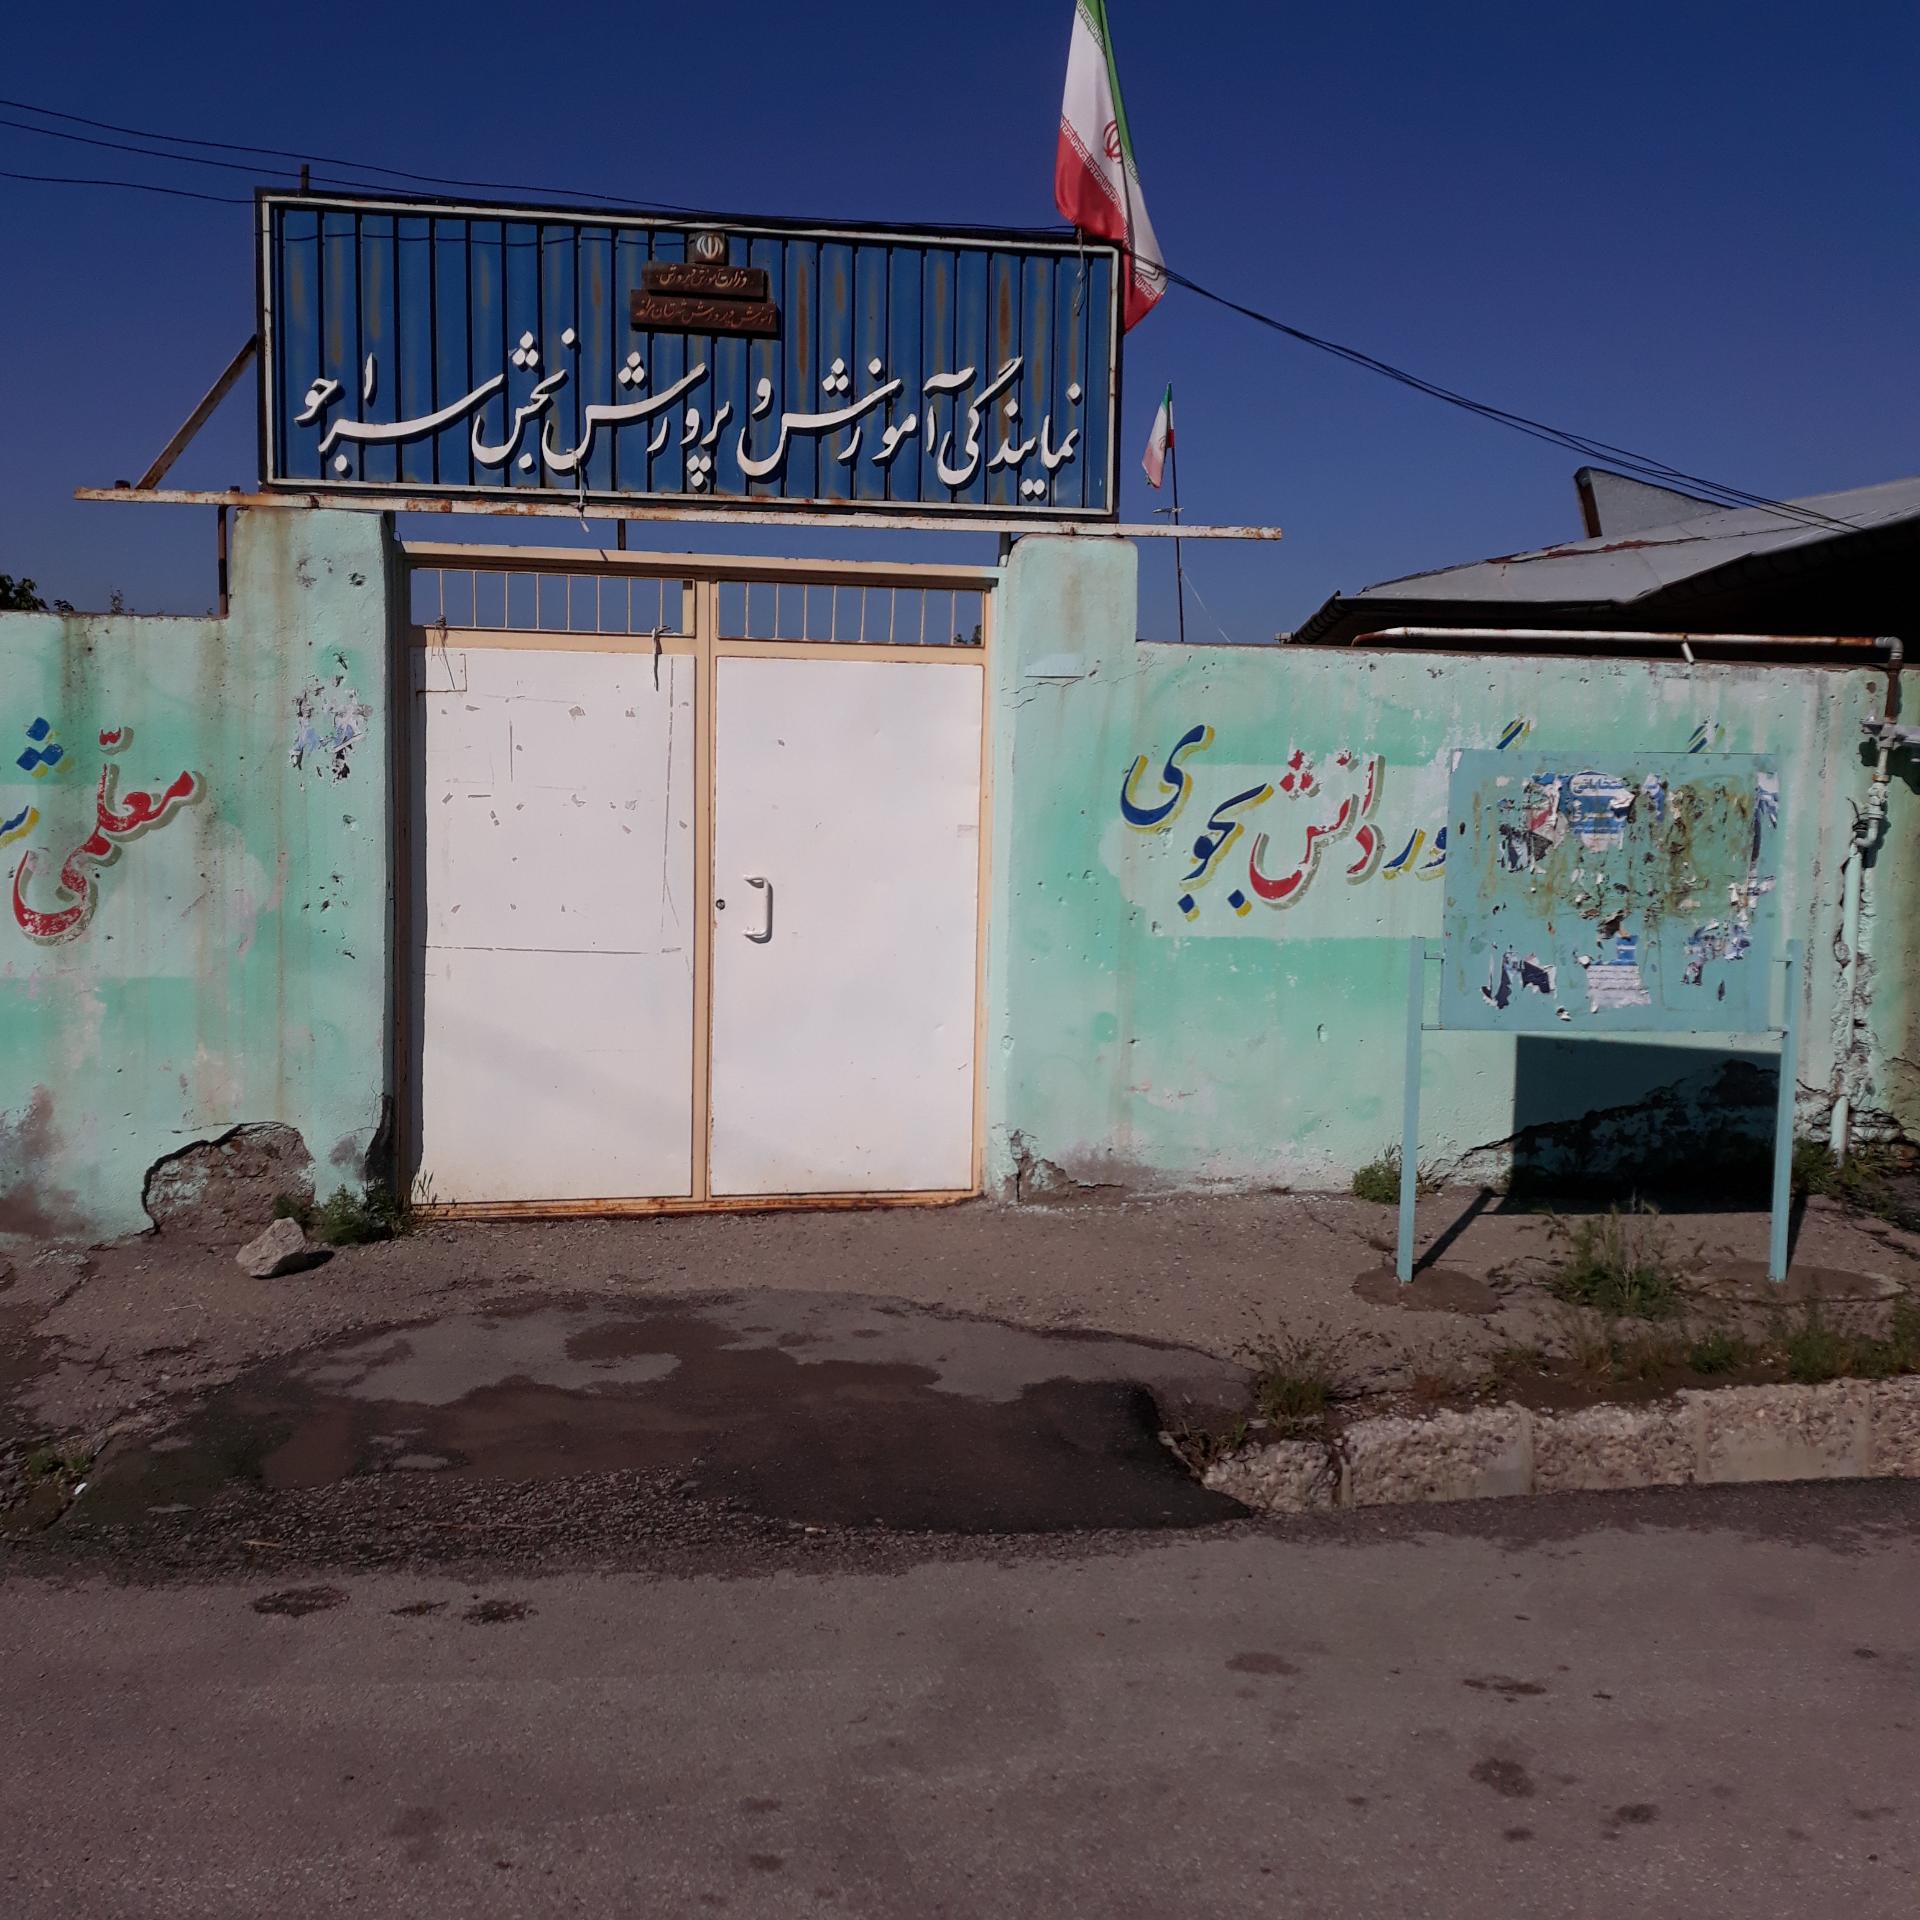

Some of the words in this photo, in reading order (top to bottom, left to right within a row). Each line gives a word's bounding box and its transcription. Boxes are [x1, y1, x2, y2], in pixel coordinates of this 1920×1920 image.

[681, 300, 729, 326] پرورش
[691, 267, 725, 288] آموزش
[714, 270, 748, 288] وزارت
[730, 305, 775, 329] آموزش
[471, 328, 576, 470] بخش
[541, 351, 730, 488] پرورش
[737, 357, 976, 477] آموزش
[752, 376, 773, 415] و
[936, 356, 1081, 500] نمایندگی
[1249, 749, 1386, 911] دانش
